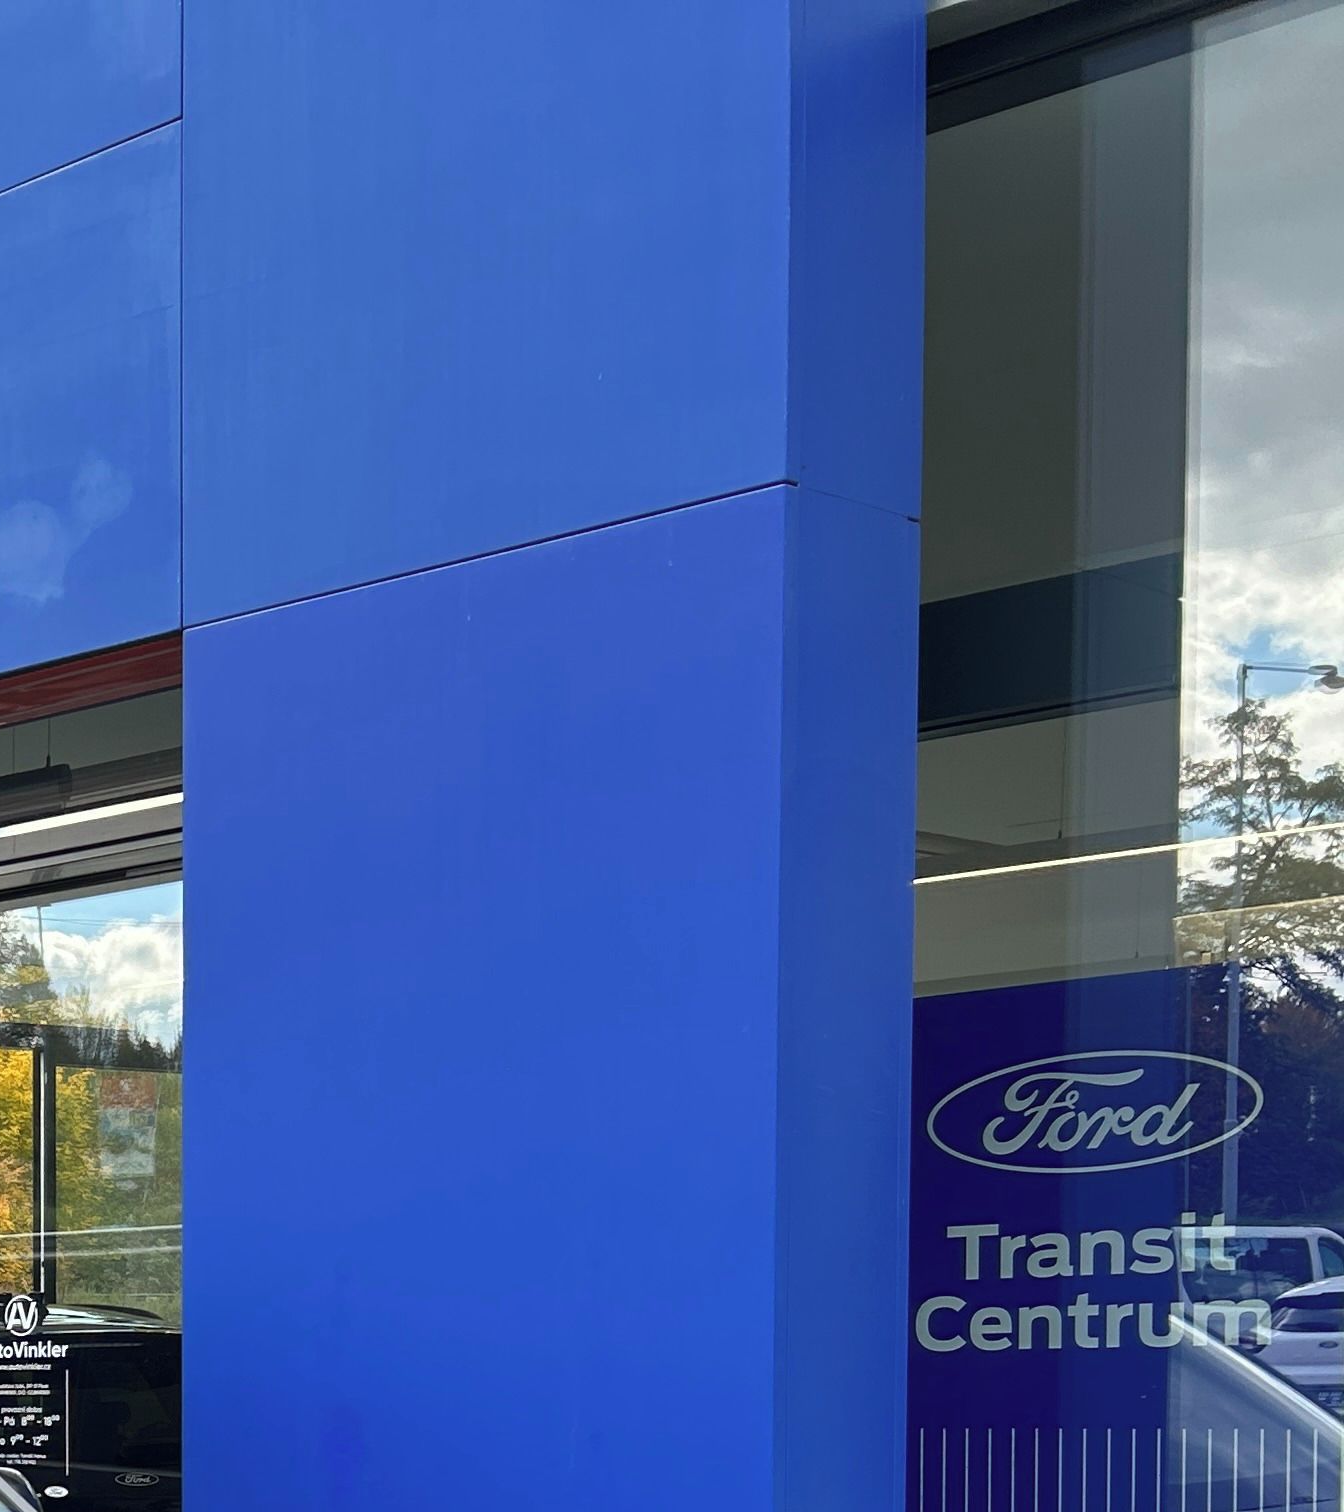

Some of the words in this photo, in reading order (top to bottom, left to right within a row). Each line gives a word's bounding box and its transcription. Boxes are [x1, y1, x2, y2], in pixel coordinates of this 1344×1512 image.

[982, 1068, 1201, 1155] Ford
[946, 1211, 1236, 1281] Transit
[915, 1292, 1273, 1353] Centrum
